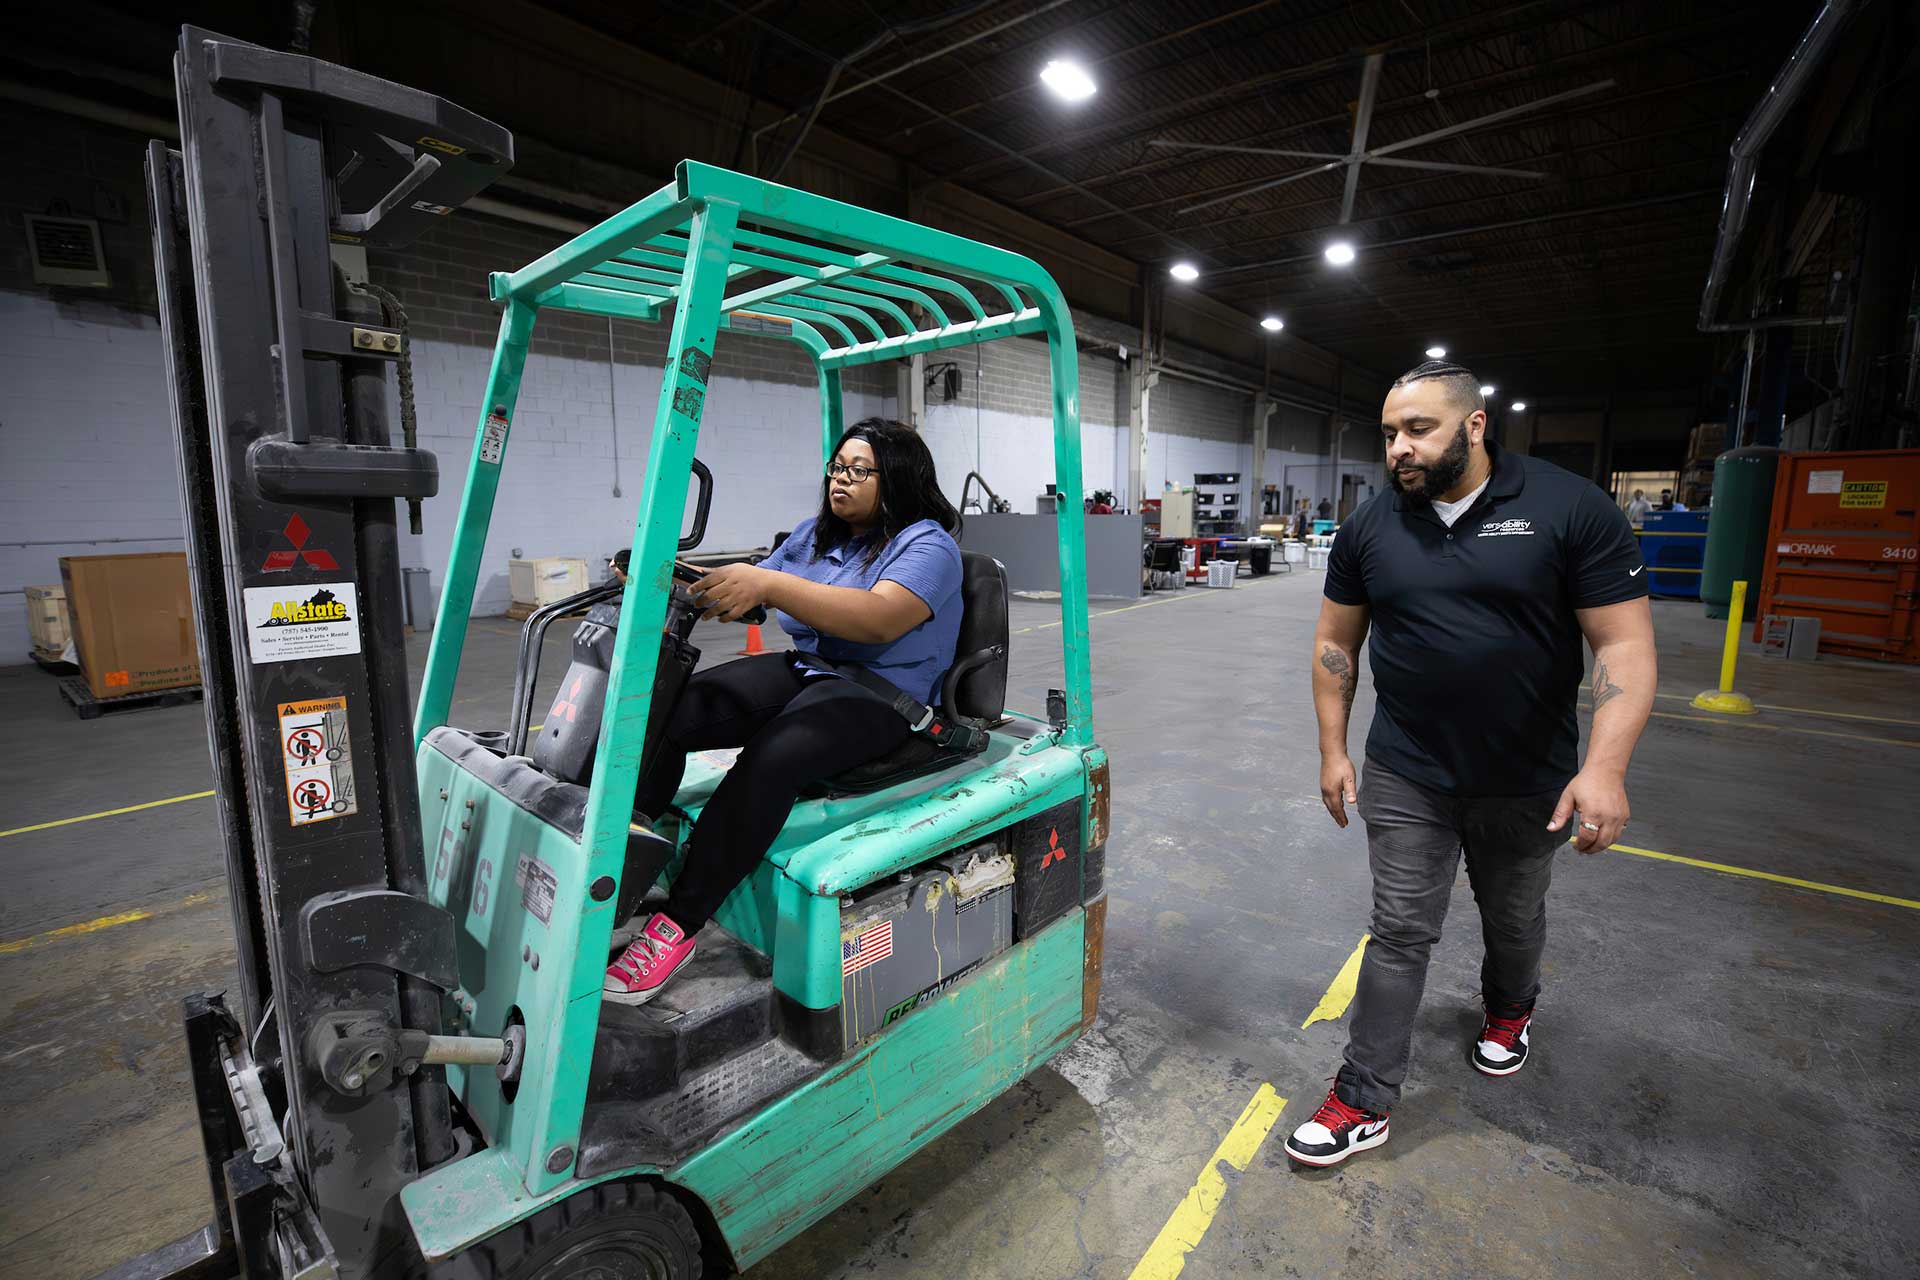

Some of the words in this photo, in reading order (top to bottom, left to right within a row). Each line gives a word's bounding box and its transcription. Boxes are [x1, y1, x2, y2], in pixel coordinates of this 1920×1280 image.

[1846, 483, 1885, 492] CAUTION
[1791, 543, 1837, 555] ORWAK
[1882, 546, 1917, 560] 3410
[271, 600, 346, 622] Allstate
[299, 702, 341, 713] WARNING
